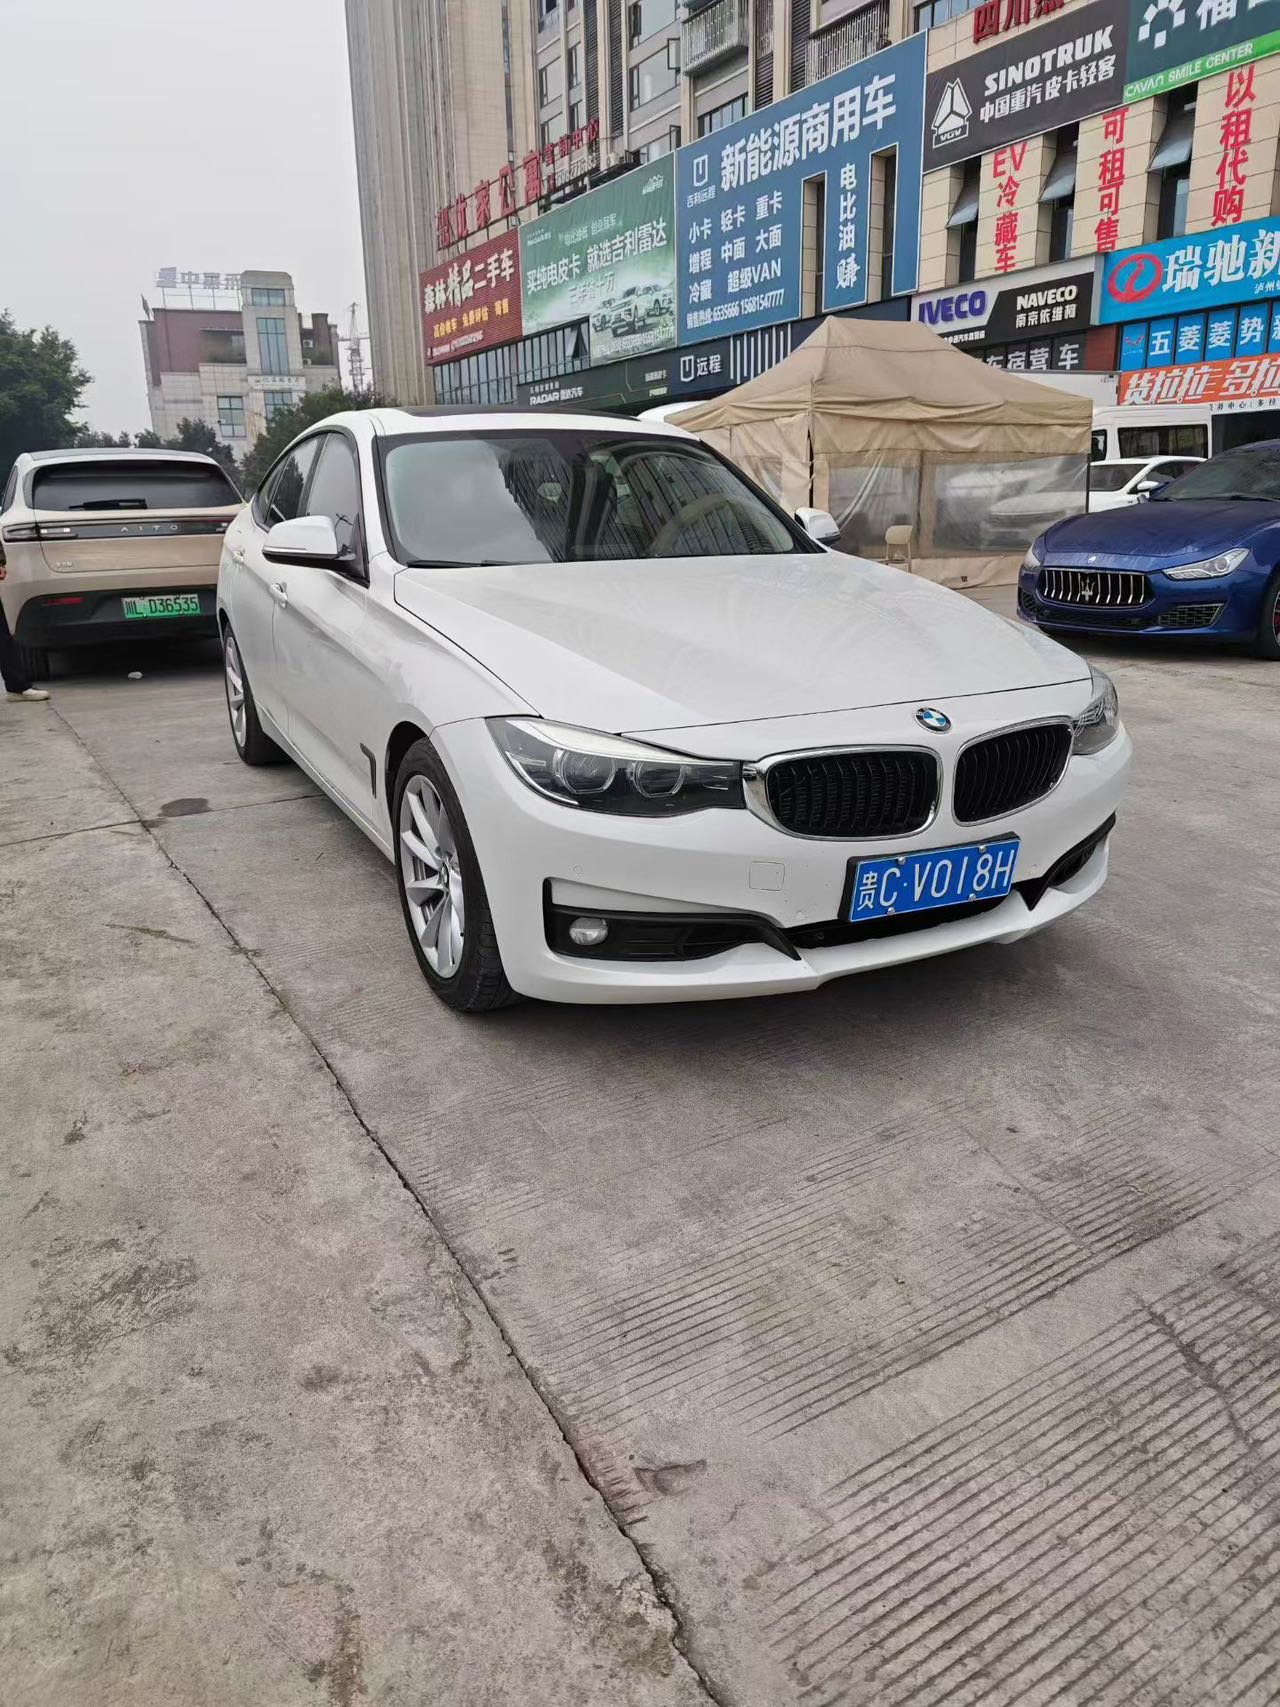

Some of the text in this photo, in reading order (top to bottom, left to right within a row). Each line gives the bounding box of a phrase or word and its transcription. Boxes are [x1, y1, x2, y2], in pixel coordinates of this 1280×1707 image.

[984, 24, 1114, 97] SINOTRUK
[1168, 61, 1203, 83] SMILE
[1206, 42, 1254, 69] CENTER
[979, 54, 1116, 124] 中国重汽皮卡轻客
[720, 74, 896, 191] 新能源商用车
[940, 128, 962, 141] VGV
[1210, 64, 1256, 227] 以租代购
[1094, 107, 1130, 254] 可租可售
[688, 190, 782, 244] 小卡 轻卡 重卡
[835, 163, 860, 289] 电比油赚
[526, 217, 667, 295] 买纯电皮卡 就选吉利雷达
[688, 223, 782, 274] 增程 中面 大面
[688, 278, 712, 304] 冷藏
[918, 290, 986, 325] IVECO
[1016, 285, 1077, 311] NAVECO
[1015, 303, 1077, 329] 南京依维柯
[696, 354, 722, 377] 远程
[1124, 364, 1221, 405] 货拉拉
[529, 391, 559, 406] RADAR
[121, 524, 178, 532] AITO
